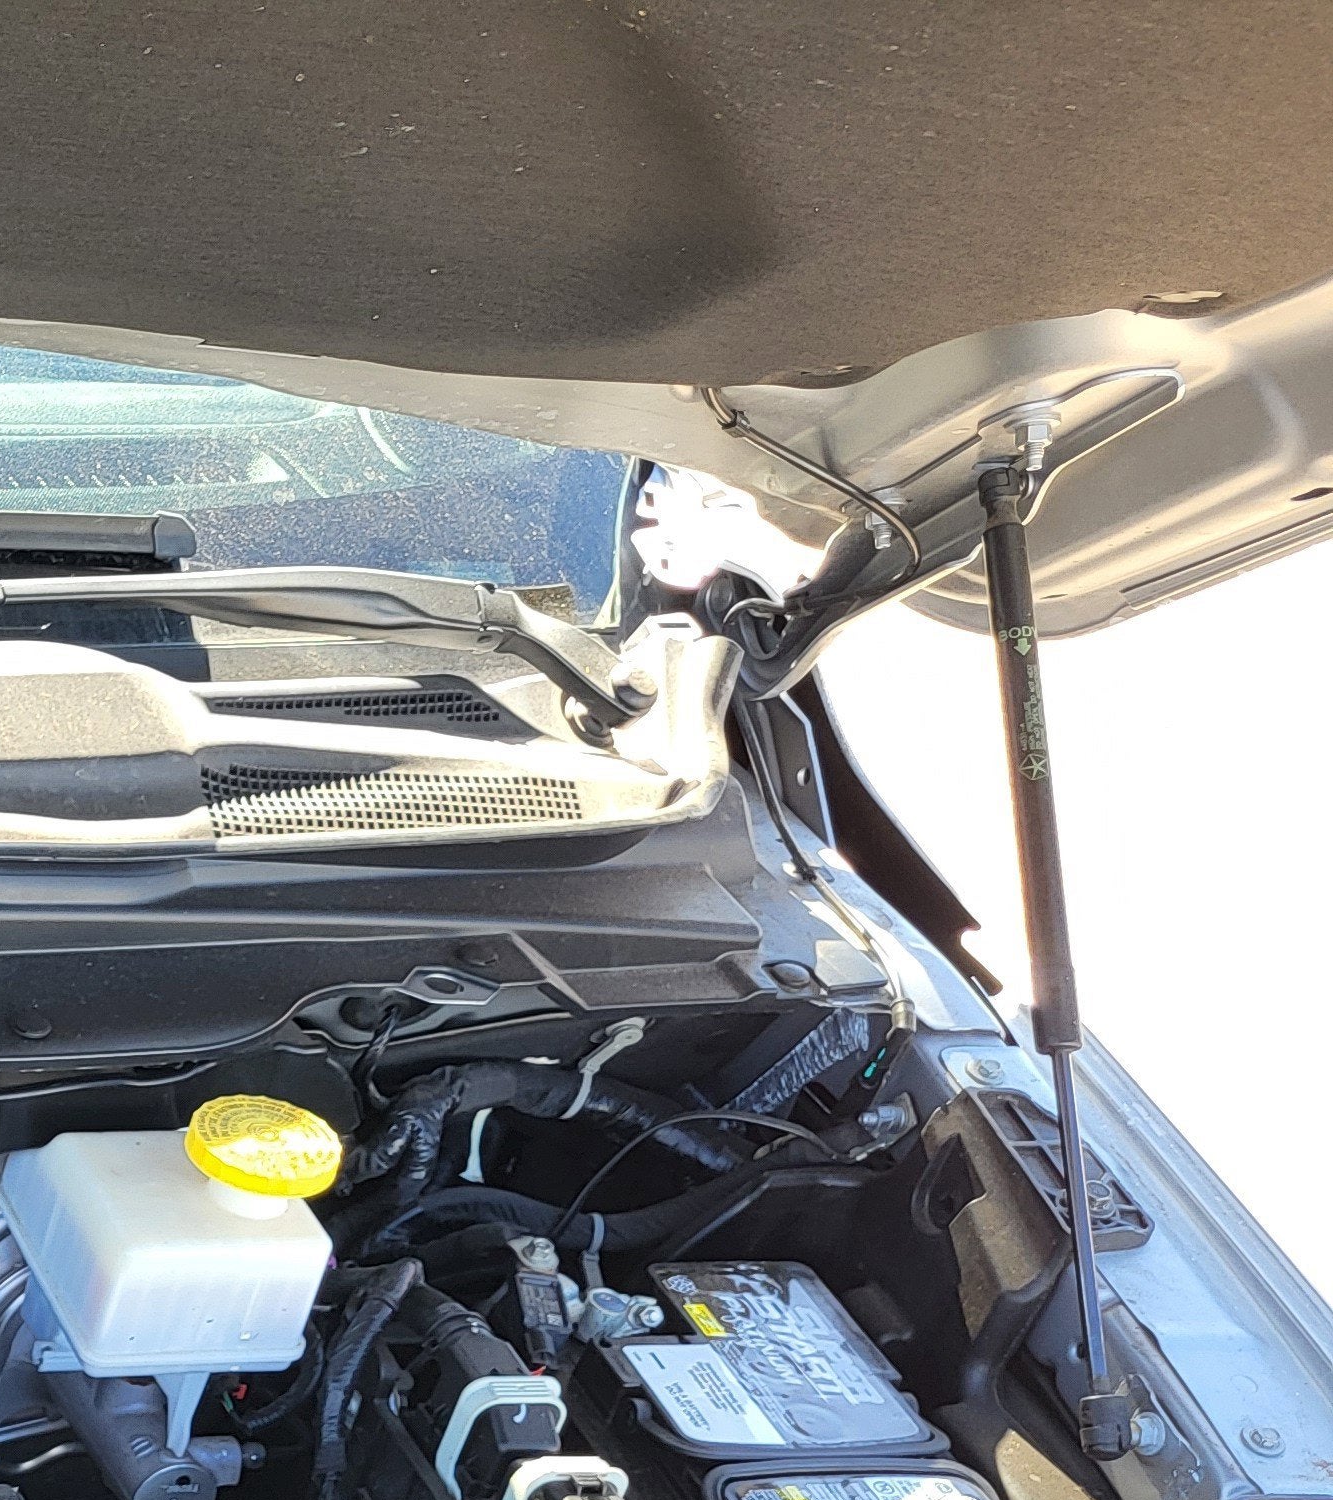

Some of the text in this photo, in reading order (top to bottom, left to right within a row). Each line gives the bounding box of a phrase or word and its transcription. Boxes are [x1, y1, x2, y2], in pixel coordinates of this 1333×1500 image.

[998, 625, 1038, 642] BODY
[749, 1298, 845, 1400] START
[791, 1303, 879, 1402] SUPER
